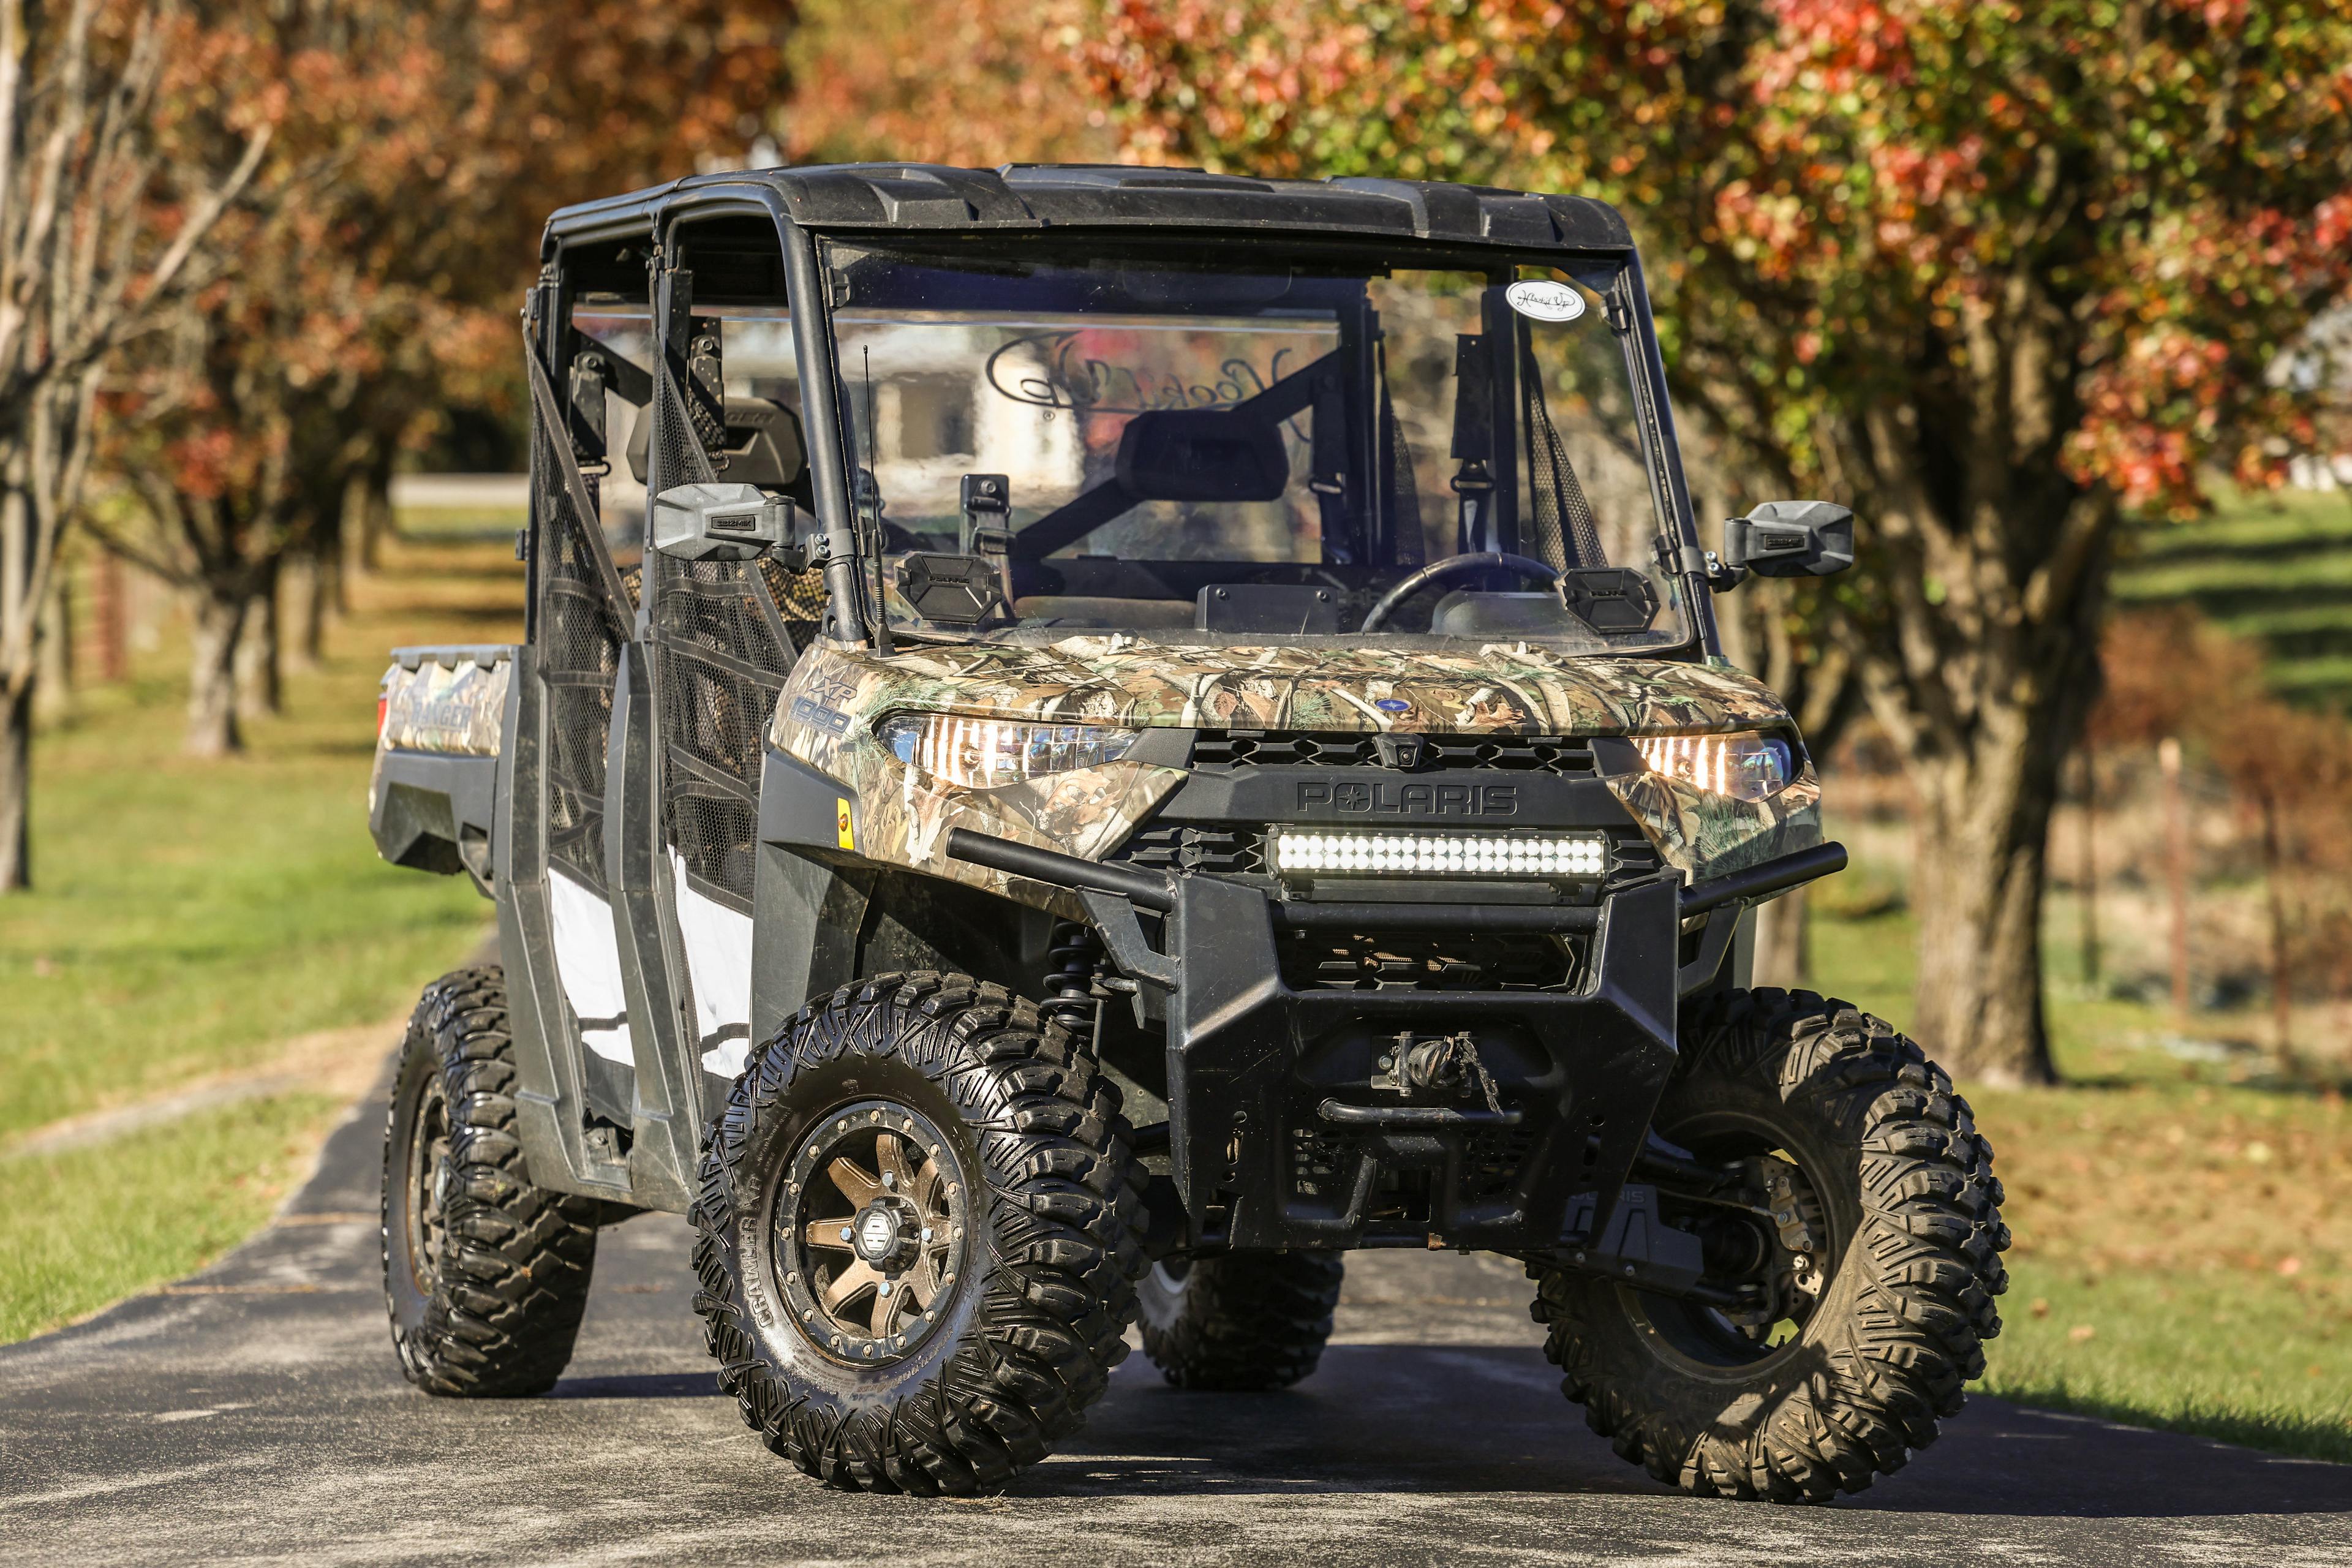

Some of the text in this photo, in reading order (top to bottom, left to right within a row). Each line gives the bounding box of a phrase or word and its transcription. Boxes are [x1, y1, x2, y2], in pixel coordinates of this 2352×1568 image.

[809, 676, 858, 701] XP
[410, 701, 472, 729] RANGER
[790, 695, 852, 734] 1000
[1297, 782, 1518, 816] POLARIS
[741, 1218, 774, 1329] CRAWLER
